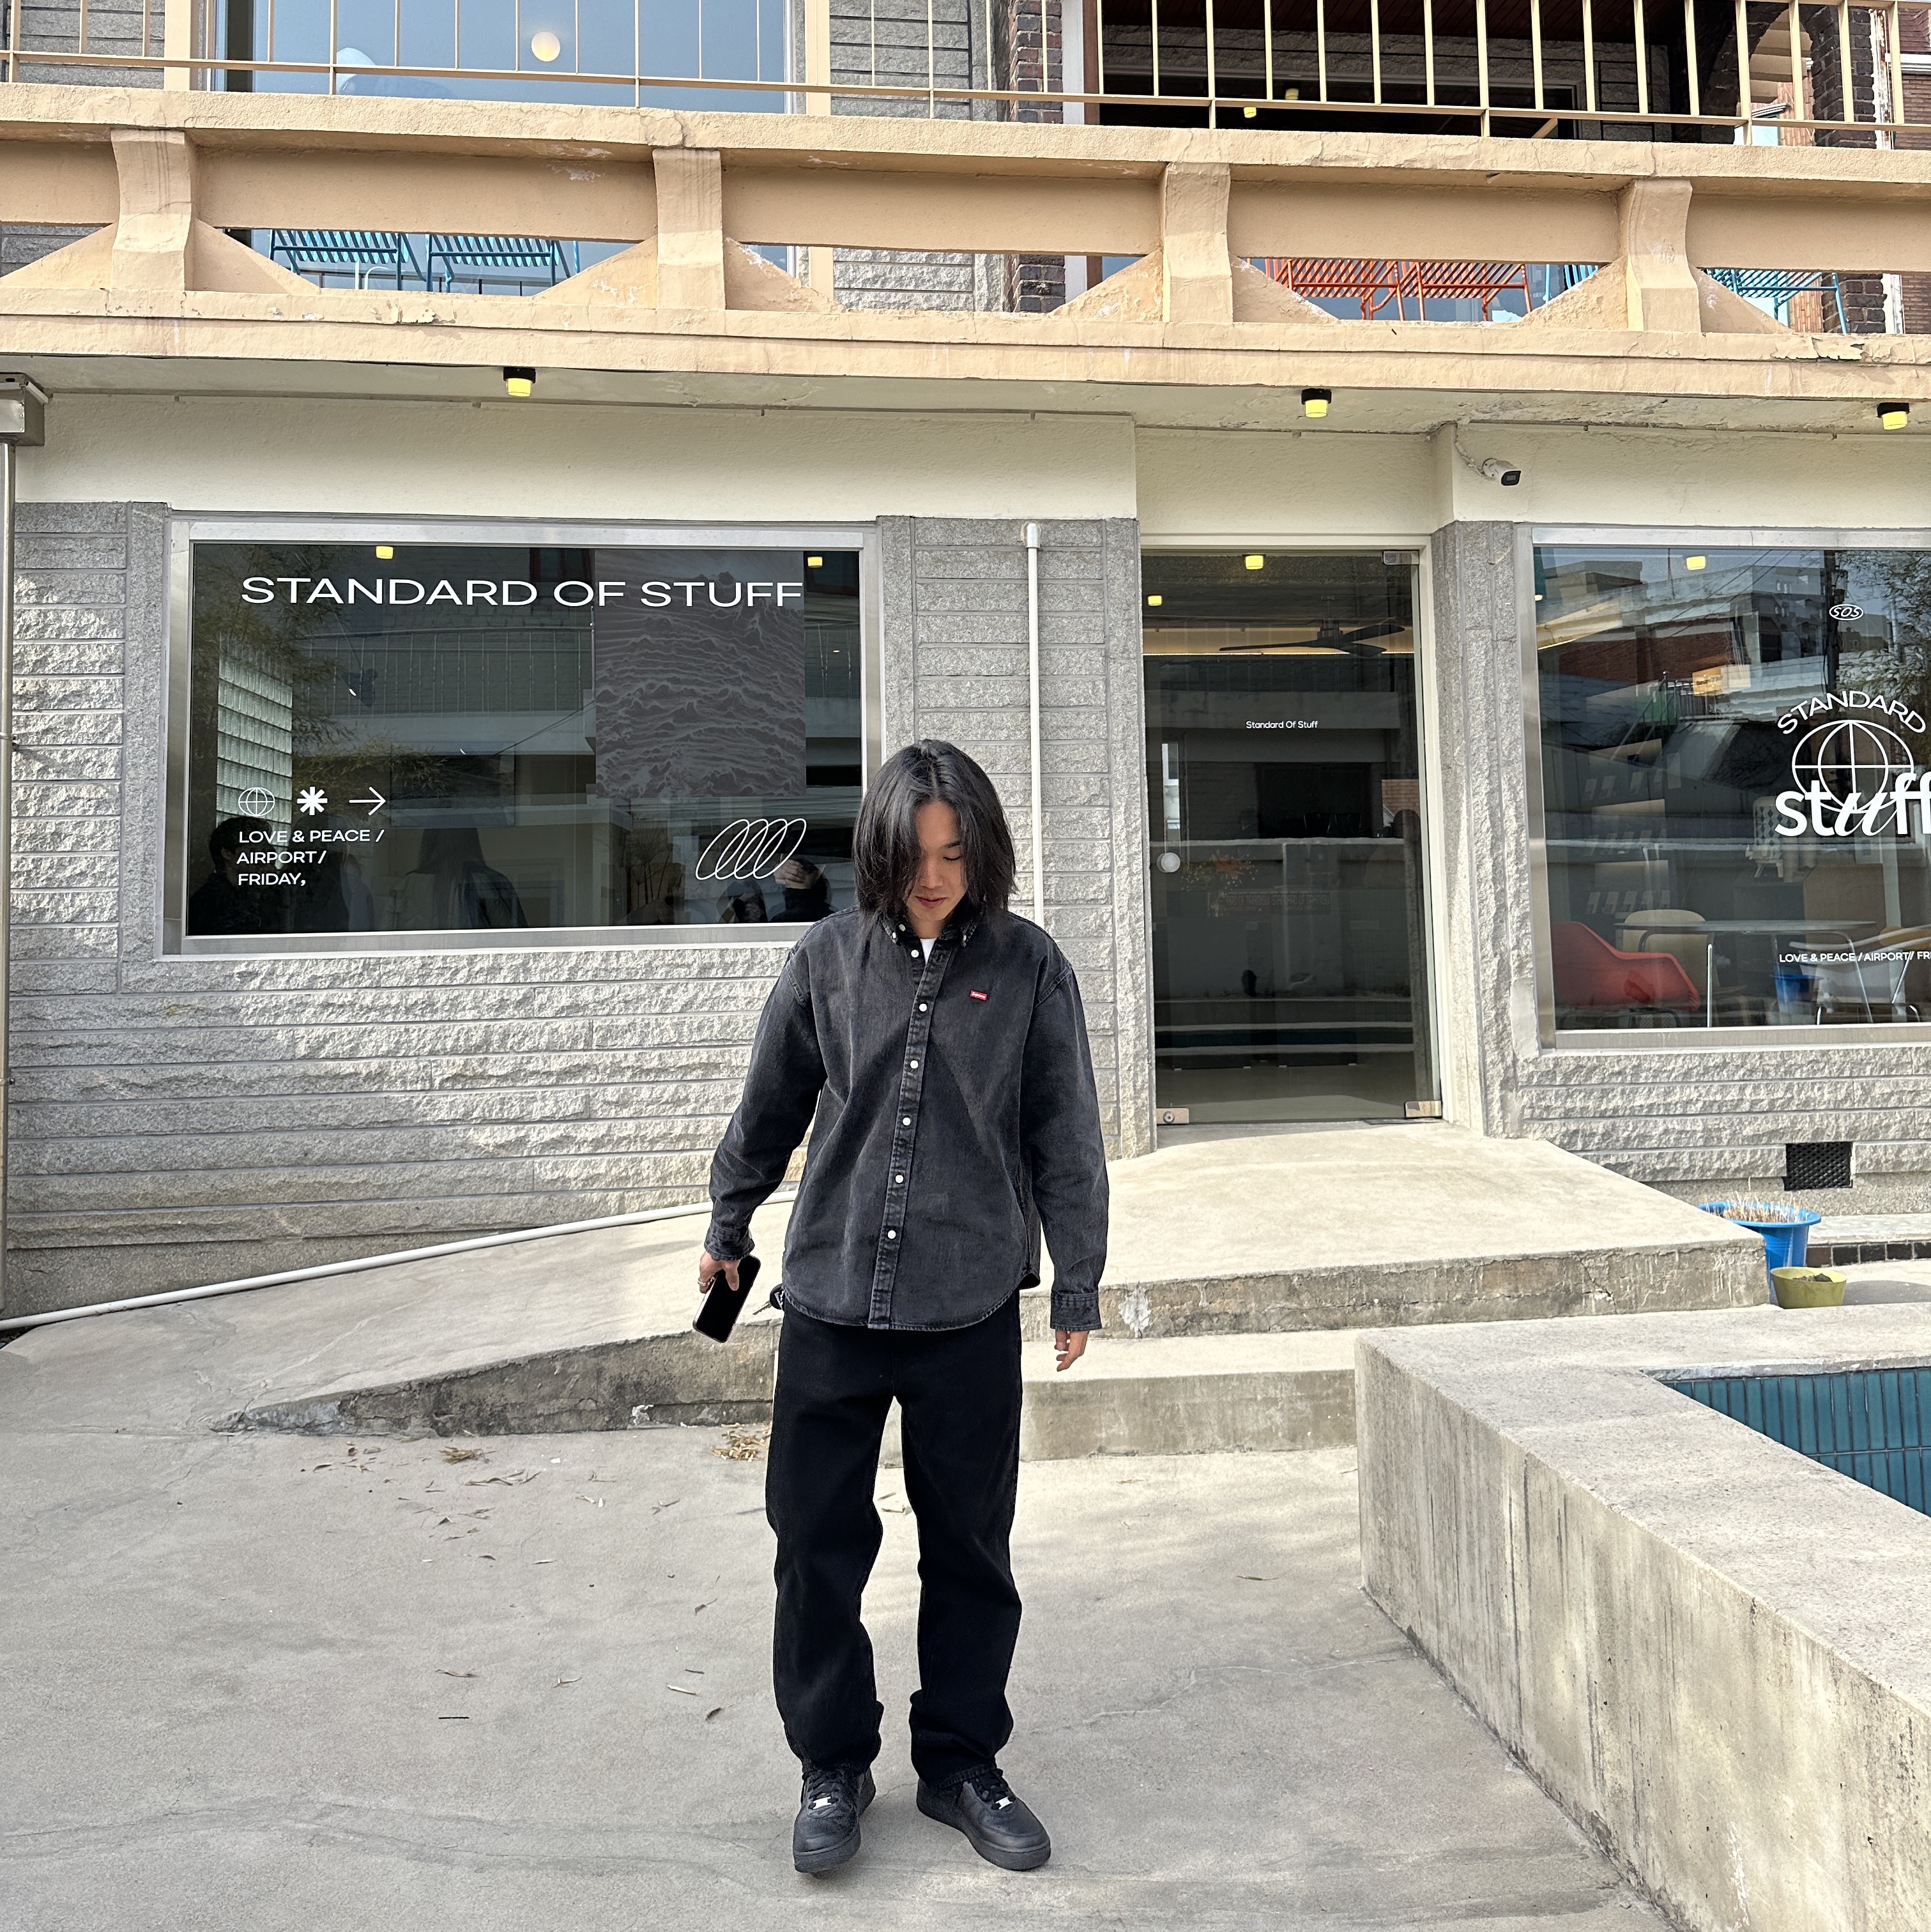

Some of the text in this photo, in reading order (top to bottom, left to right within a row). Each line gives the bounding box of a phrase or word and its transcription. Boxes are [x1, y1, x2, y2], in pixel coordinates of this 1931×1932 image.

[241, 577, 803, 607] STANDARD OF STUFF
[1832, 606, 1861, 618] SOS
[1777, 690, 1926, 734] STANDARD
[1246, 720, 1318, 729] Standard Of Stuff
[239, 830, 287, 843] LOVE
[292, 830, 305, 842] &
[310, 829, 370, 842] PEACE
[238, 872, 306, 886] FRIDAY,
[1779, 953, 1808, 963] LOVE
[1810, 953, 1818, 962] &
[1820, 952, 1856, 962] PEACE
